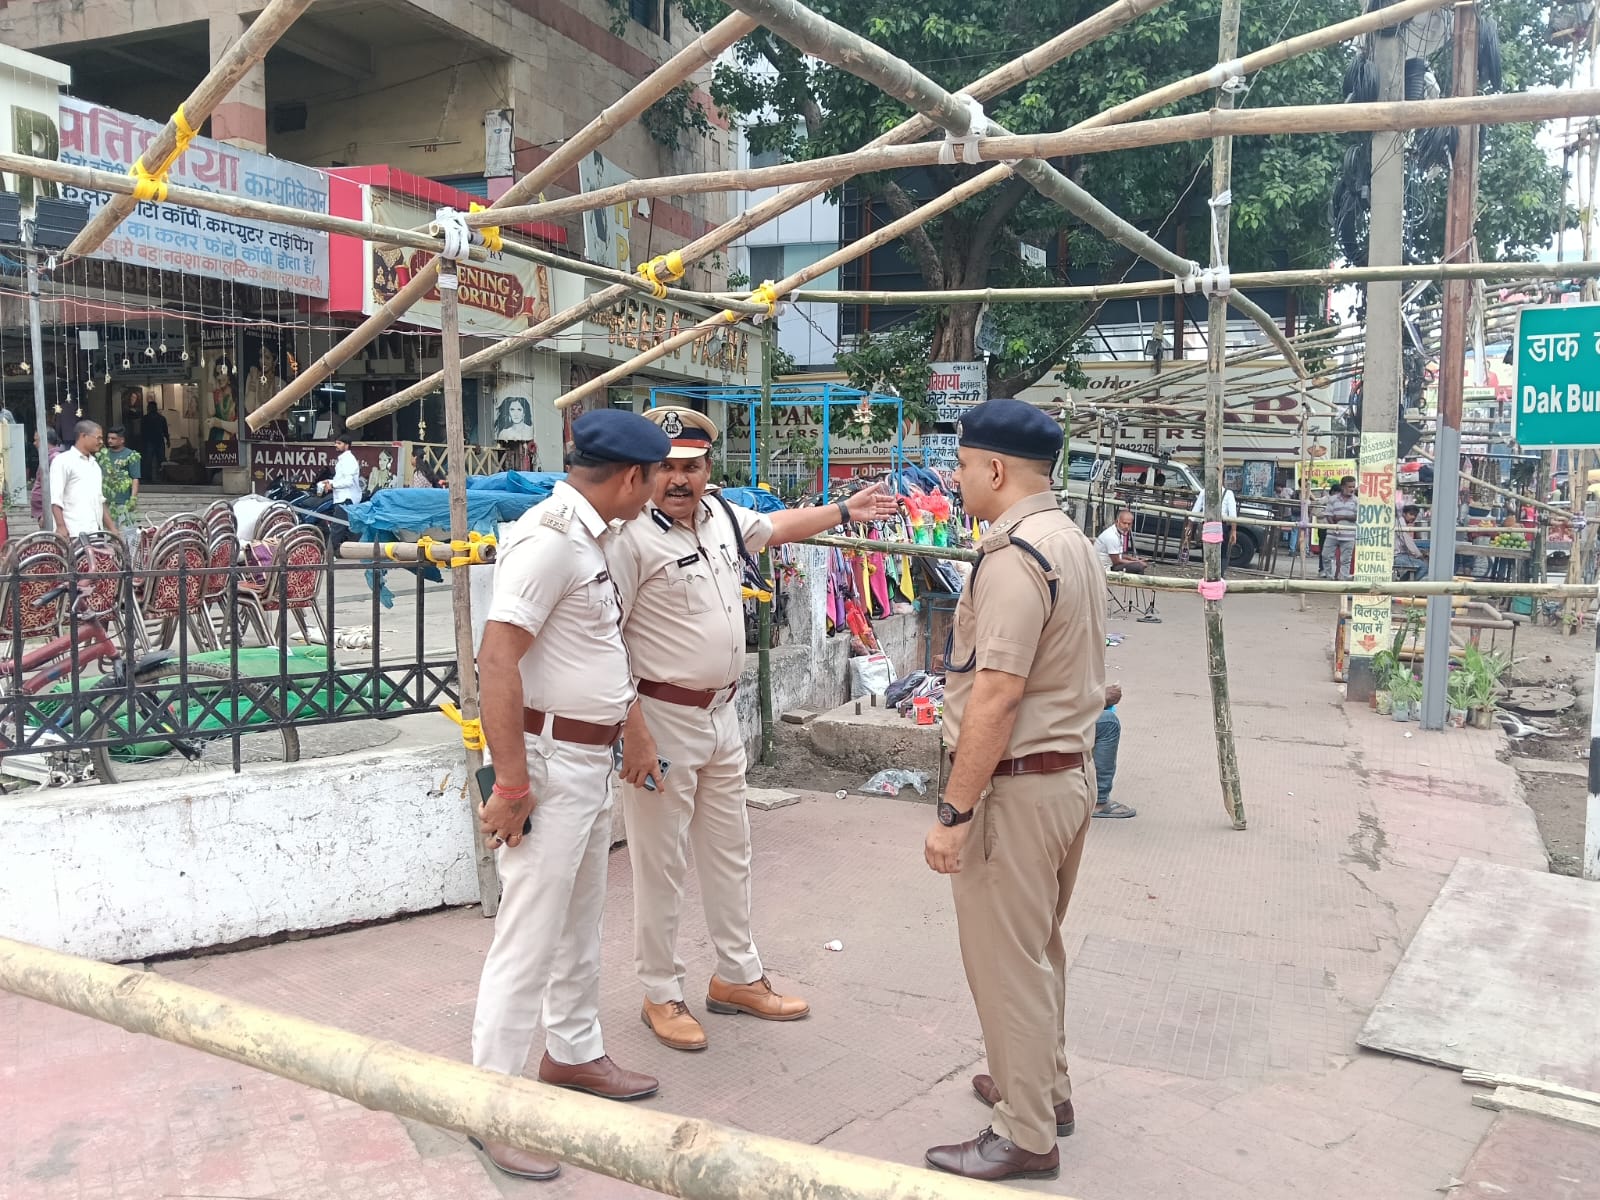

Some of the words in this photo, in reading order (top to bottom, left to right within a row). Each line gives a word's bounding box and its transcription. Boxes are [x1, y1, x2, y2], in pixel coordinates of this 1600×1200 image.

[1526, 332, 1581, 362] डाक
[1522, 384, 1563, 414] Dak
[254, 451, 328, 466] ALANKAR
[1358, 504, 1393, 524] BOY'S
[1356, 526, 1392, 548] HOSTEL
[1358, 551, 1387, 562] HOTEL
[1357, 563, 1387, 573] KUNAL
